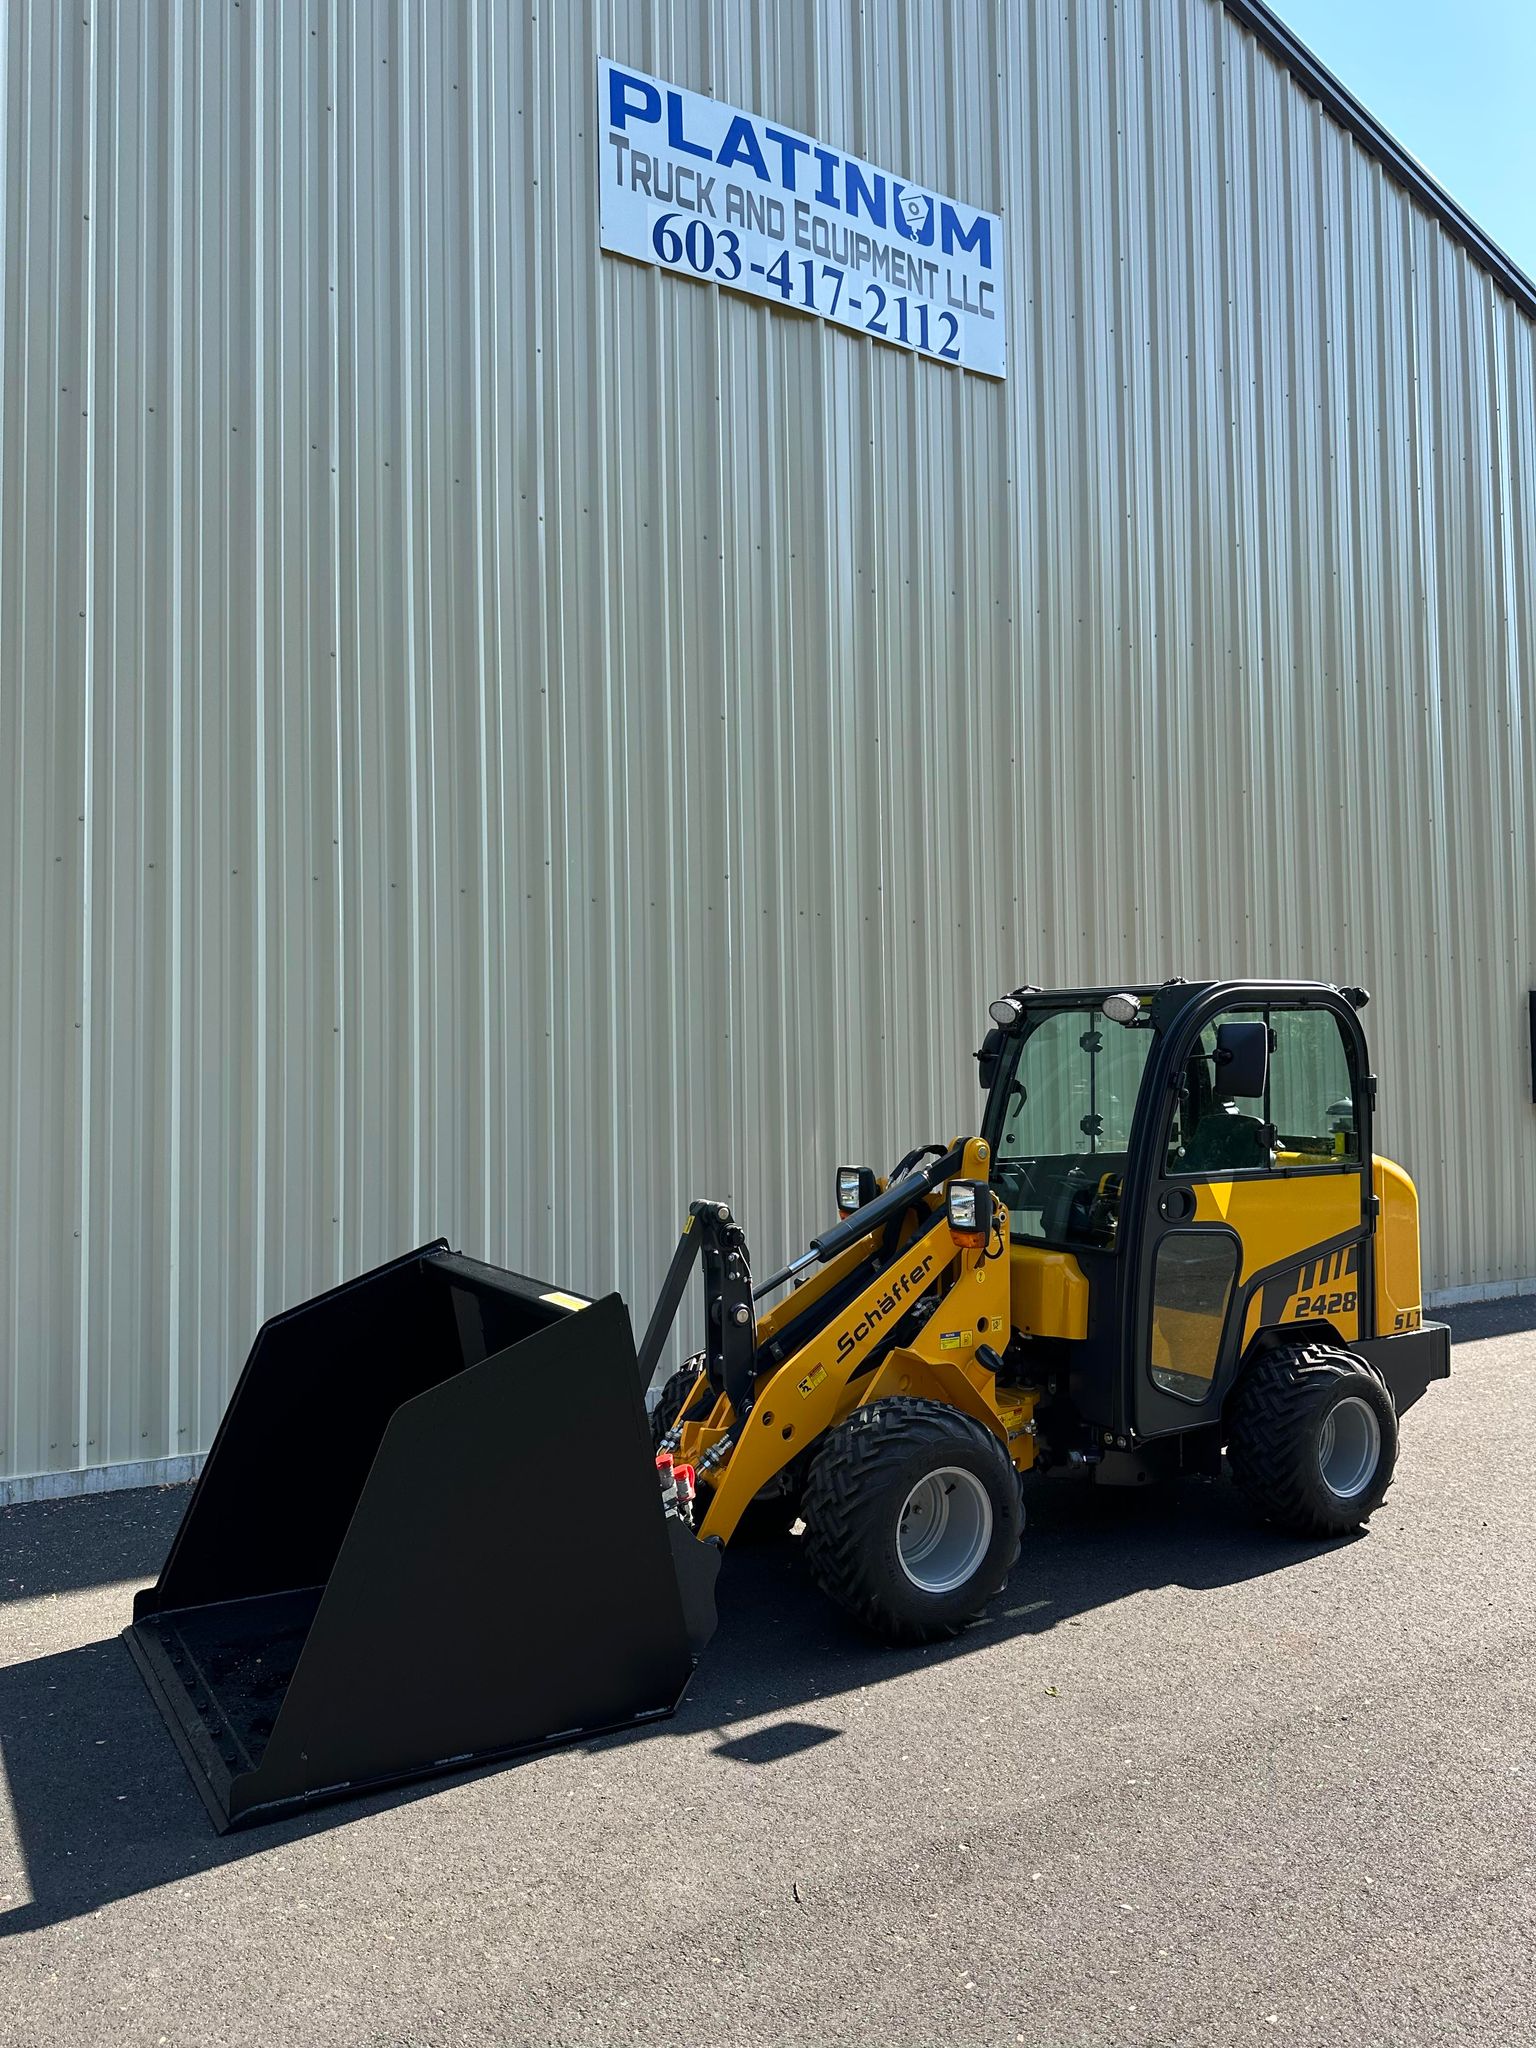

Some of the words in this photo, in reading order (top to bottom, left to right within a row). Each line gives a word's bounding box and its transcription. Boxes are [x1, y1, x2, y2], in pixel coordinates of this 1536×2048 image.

[609, 69, 991, 269] PLATINUM
[609, 132, 716, 218] TRUCK
[725, 183, 785, 241] AND
[794, 199, 939, 298] EQUIPMENT
[947, 269, 995, 320] LLC
[652, 213, 961, 360] 603-417-2112
[835, 1255, 934, 1365] Schäffer
[1295, 1291, 1358, 1318] 2428
